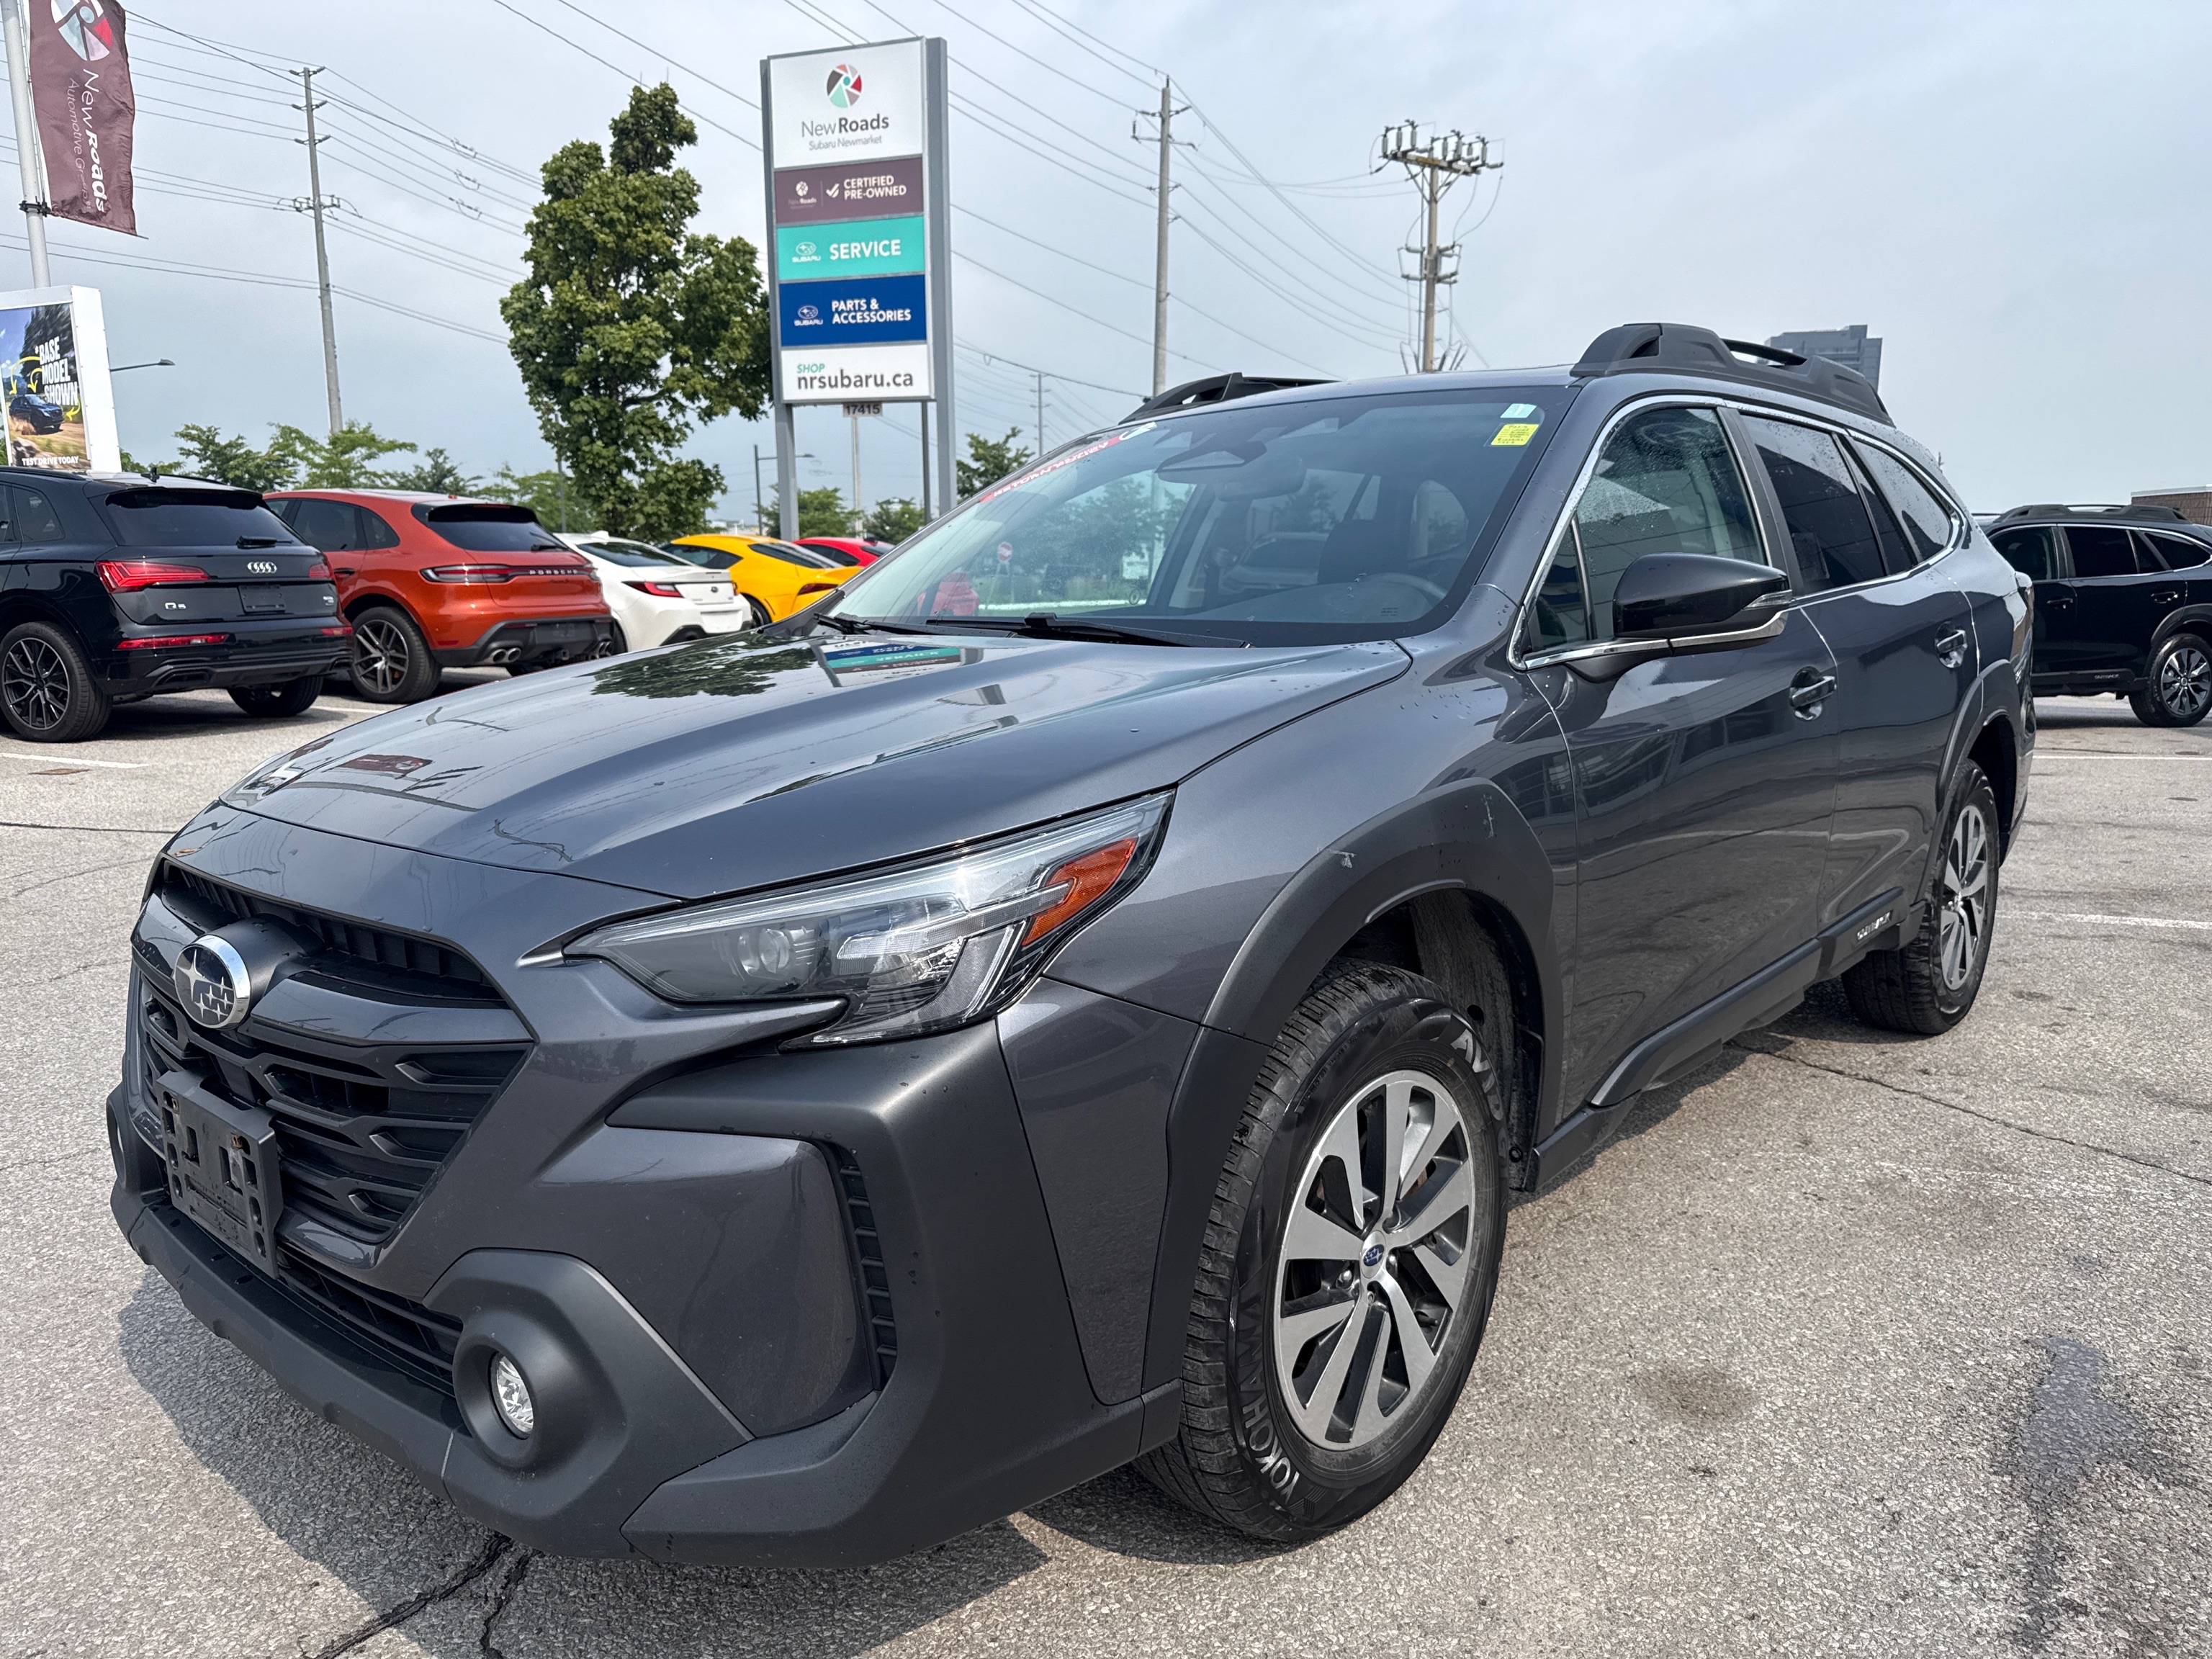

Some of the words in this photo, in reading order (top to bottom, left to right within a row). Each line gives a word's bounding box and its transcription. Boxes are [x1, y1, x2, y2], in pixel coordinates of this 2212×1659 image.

[67, 78, 83, 156] Automotive
[75, 158, 88, 204] Group
[809, 140, 836, 150] Subaru
[837, 135, 883, 148] Newmarket
[844, 175, 894, 189] CERTIFIED
[844, 185, 907, 200] PRE-OWNED
[830, 240, 902, 261] SERVICE
[832, 299, 867, 312] PARTS
[870, 297, 879, 310] &
[832, 309, 912, 325] ACCESSORIES
[42, 358, 71, 385] MODEL
[796, 363, 825, 374] SHOP
[797, 368, 914, 390] nrsubaru.ca
[44, 381, 78, 406] SHOWN
[845, 404, 881, 415] 17415
[22, 457, 38, 466] TEST
[38, 457, 58, 465] DRIVE
[58, 455, 79, 464] TODAY
[1236, 1292, 1300, 1505] YOKOHAMA
